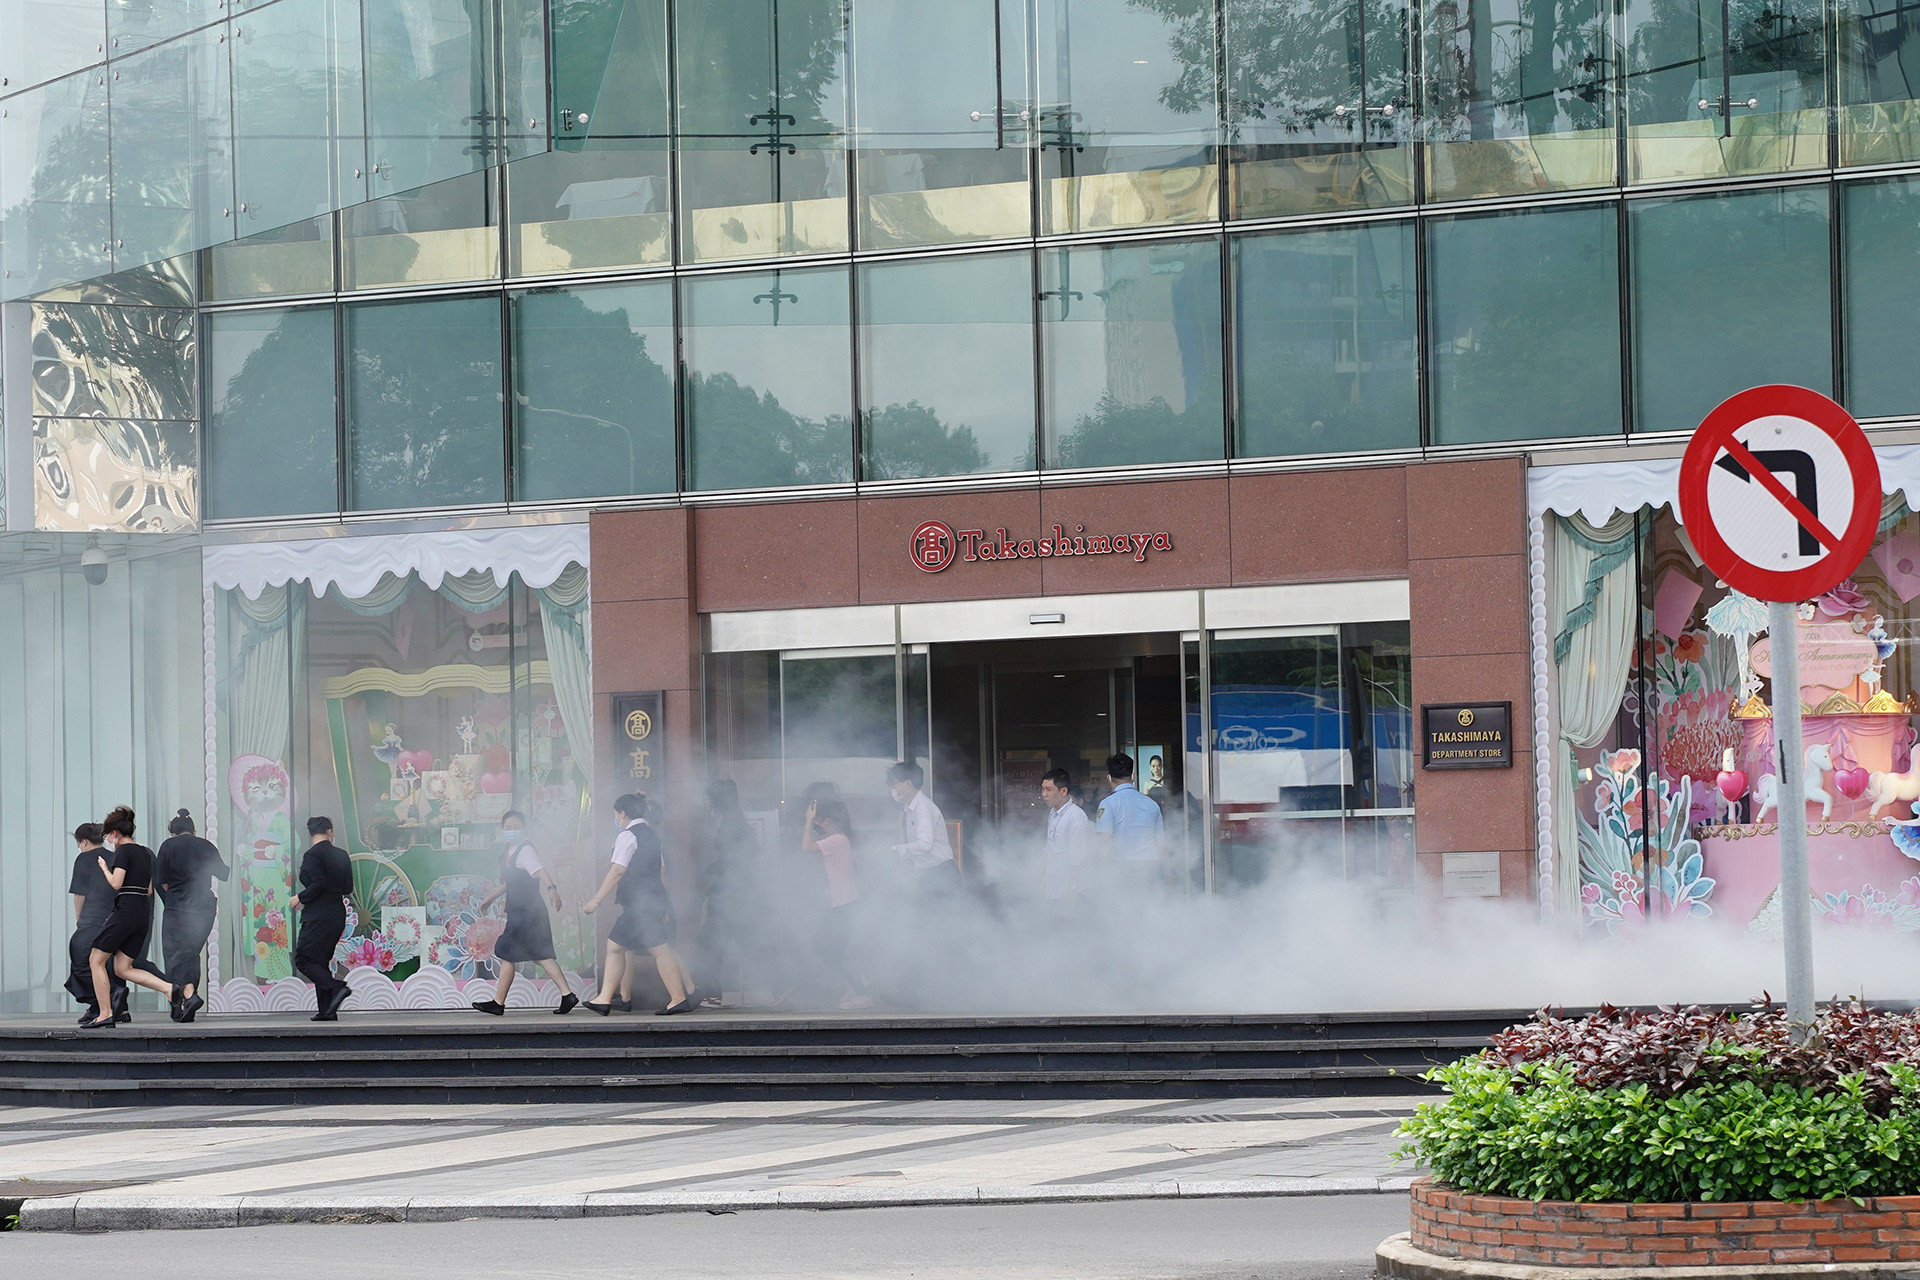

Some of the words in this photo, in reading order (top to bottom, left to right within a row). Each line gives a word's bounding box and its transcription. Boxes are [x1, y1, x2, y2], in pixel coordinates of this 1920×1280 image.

[957, 524, 1172, 562] Takashimaya
[1432, 731, 1502, 743] TAKASHIMAYA
[1432, 750, 1477, 759] DEPARTMENT
[1480, 749, 1502, 757] STORE
